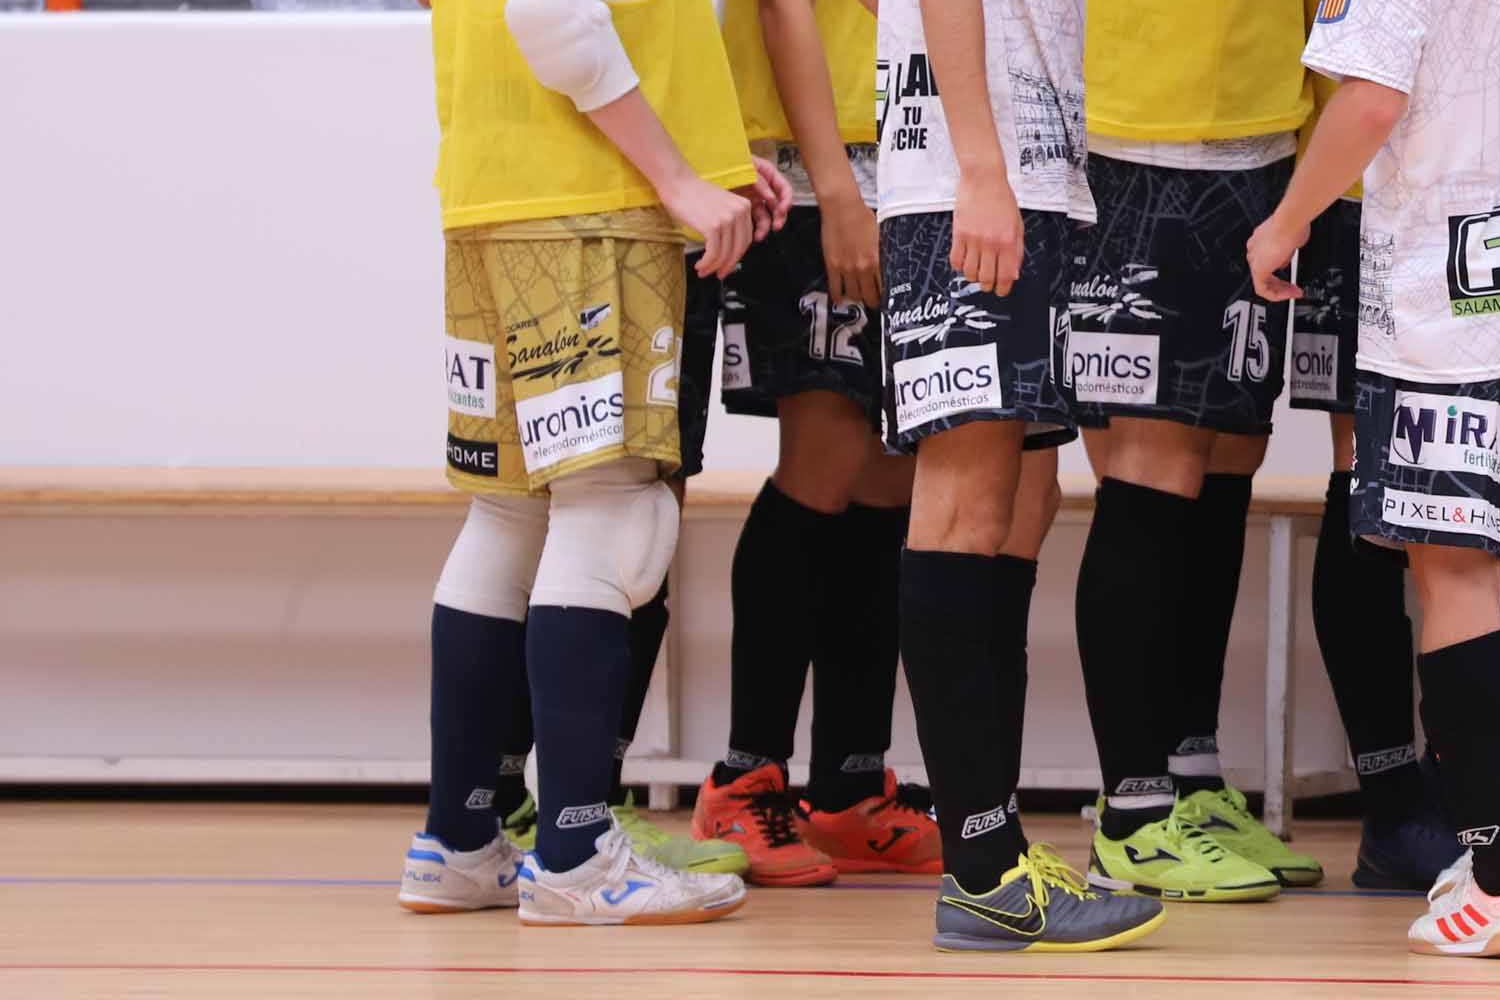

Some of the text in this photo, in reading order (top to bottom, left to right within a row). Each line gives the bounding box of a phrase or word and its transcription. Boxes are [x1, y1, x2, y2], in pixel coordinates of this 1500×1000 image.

[903, 107, 921, 126] TU
[799, 291, 868, 366] 12
[1223, 299, 1270, 383] 15
[445, 345, 491, 390] AT
